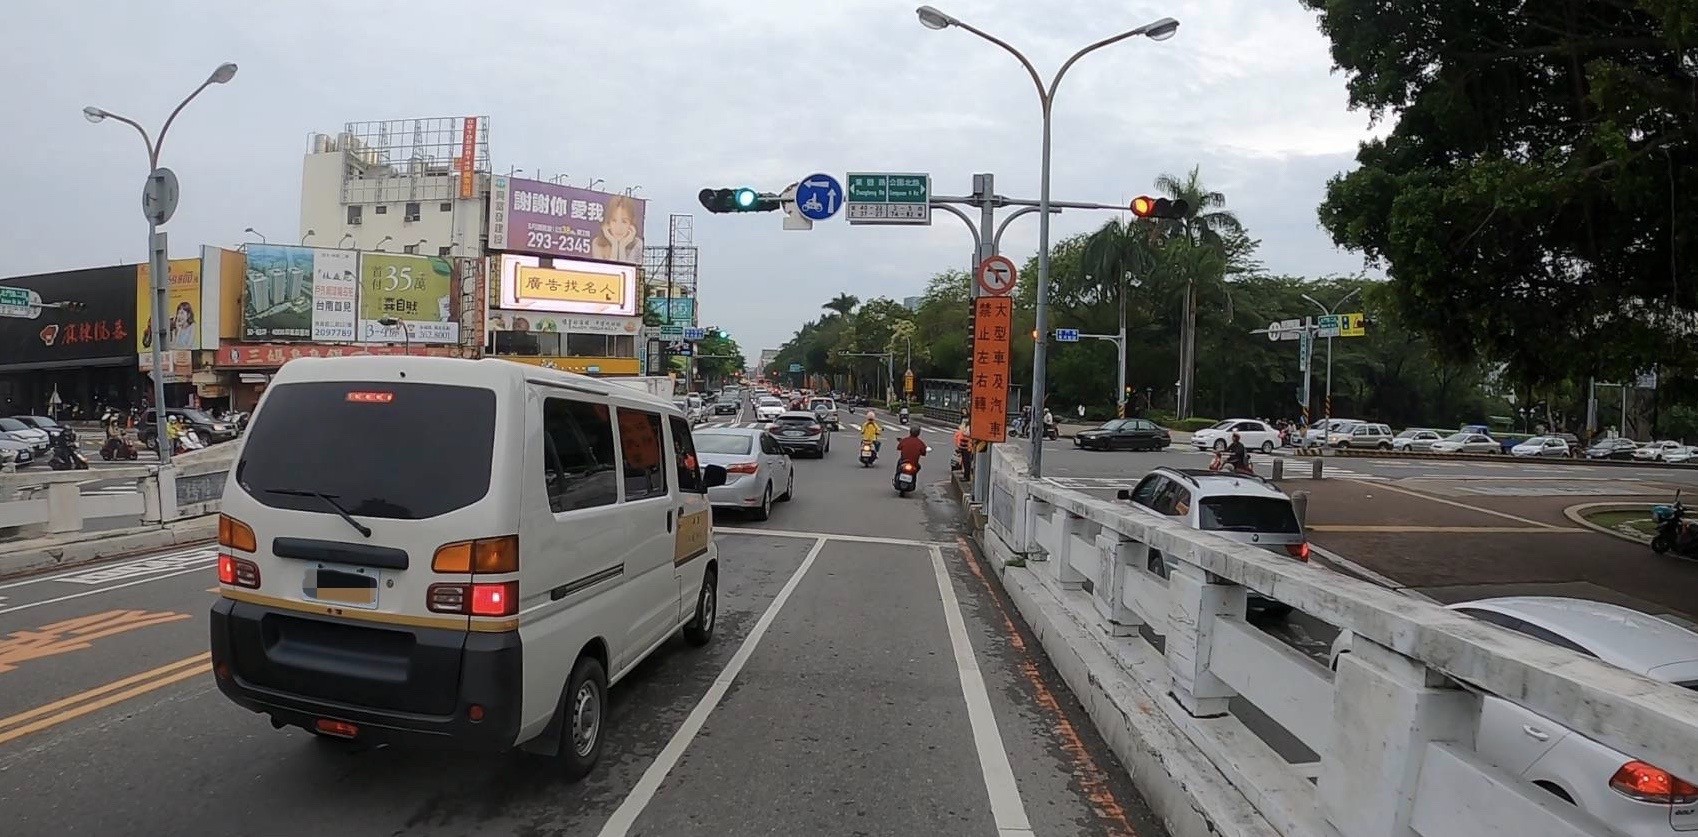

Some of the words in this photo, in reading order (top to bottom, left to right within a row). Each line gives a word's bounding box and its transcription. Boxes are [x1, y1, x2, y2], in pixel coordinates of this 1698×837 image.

[514, 190, 567, 217] 謝謝你
[571, 199, 604, 222] 愛我
[527, 231, 591, 254] 293-2345
[385, 265, 412, 291] 35
[525, 276, 615, 295] 廣告找名人
[975, 303, 992, 411] 禁止左右轉
[990, 303, 1008, 438] 大型車及汽車
